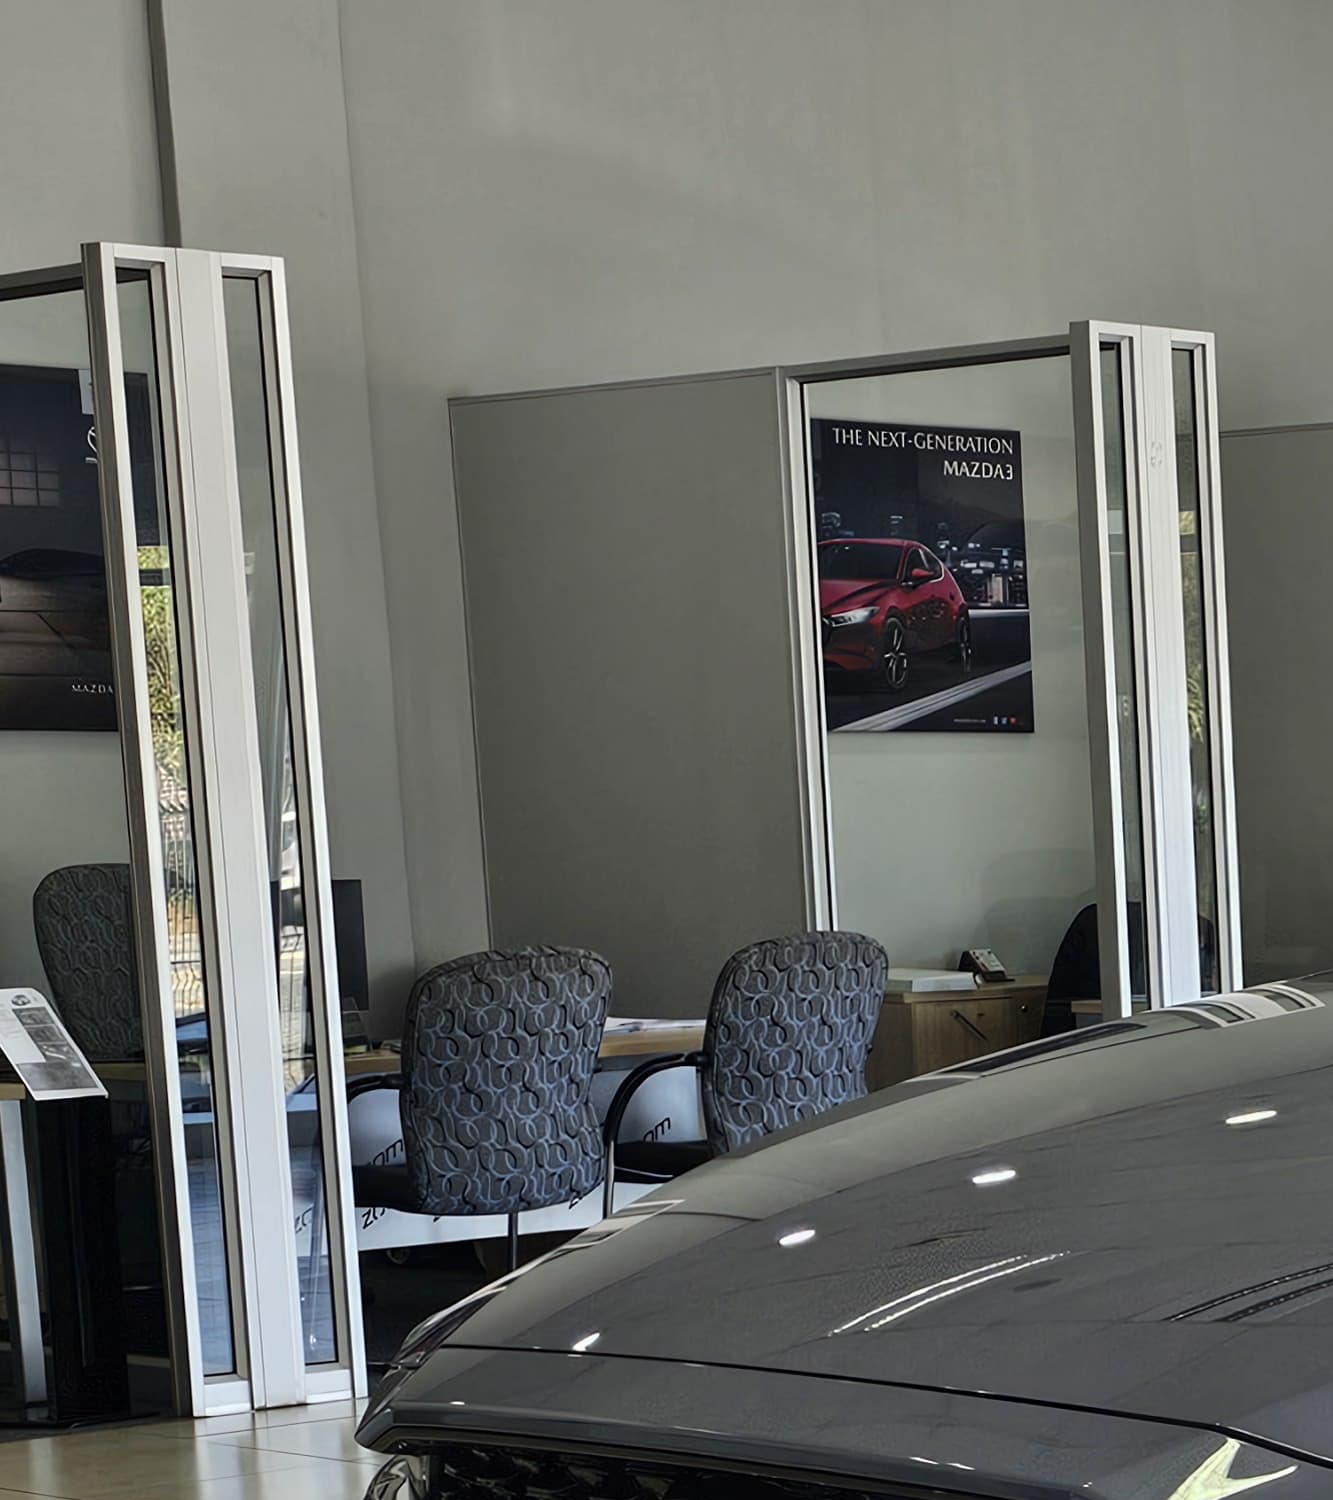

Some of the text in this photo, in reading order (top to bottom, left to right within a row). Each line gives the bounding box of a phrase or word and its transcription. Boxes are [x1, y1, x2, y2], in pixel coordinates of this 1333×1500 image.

[832, 427, 1014, 455] THE NEXT-GENERATION
[943, 460, 1014, 480] MAZDA3
